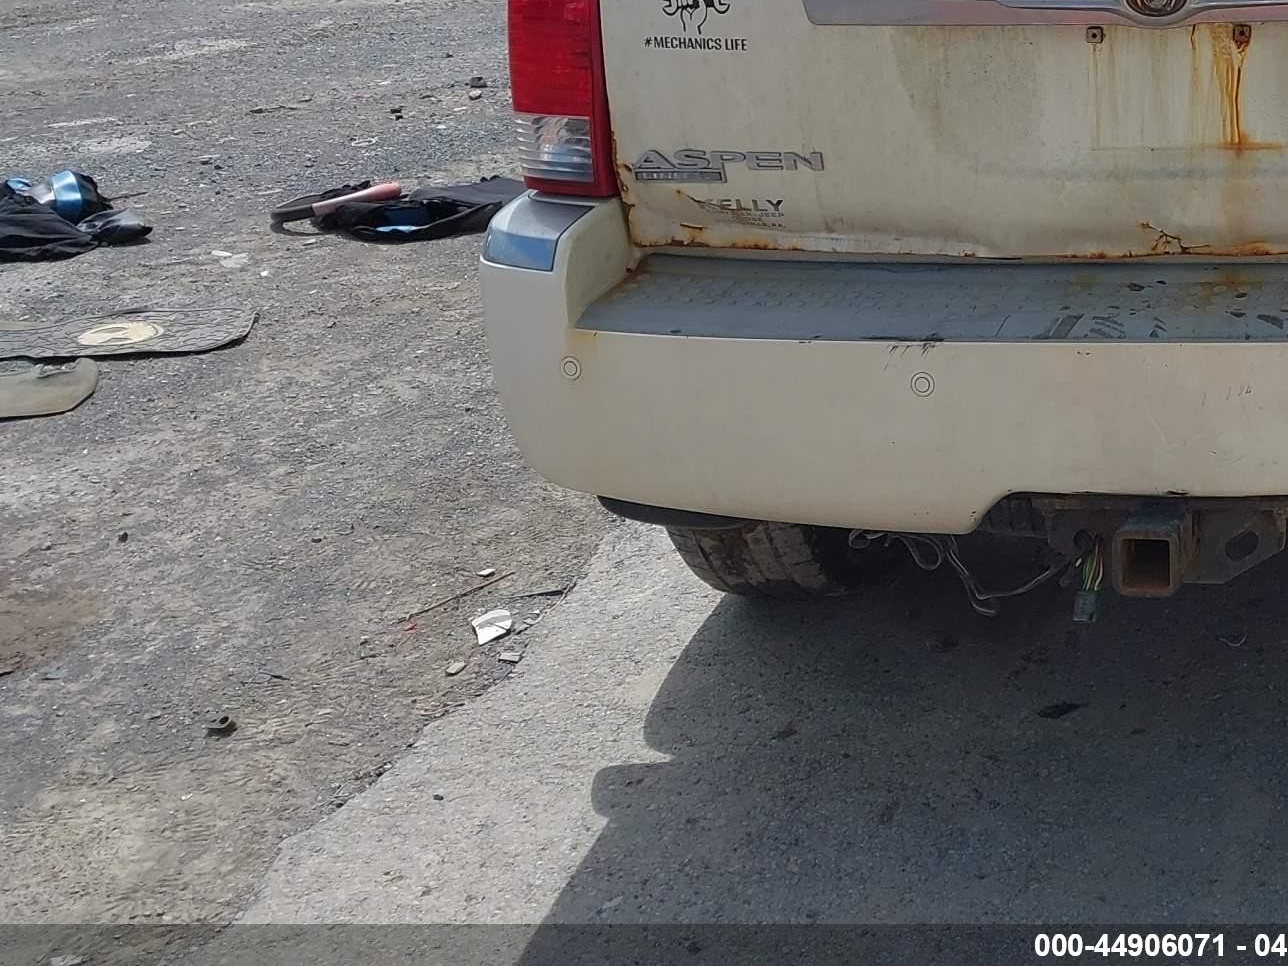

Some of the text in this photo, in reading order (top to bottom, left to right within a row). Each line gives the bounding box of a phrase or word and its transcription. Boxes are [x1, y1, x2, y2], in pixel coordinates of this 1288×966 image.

[644, 36, 748, 51] #MECHANICS LIFE
[633, 149, 825, 183] ASPEN
